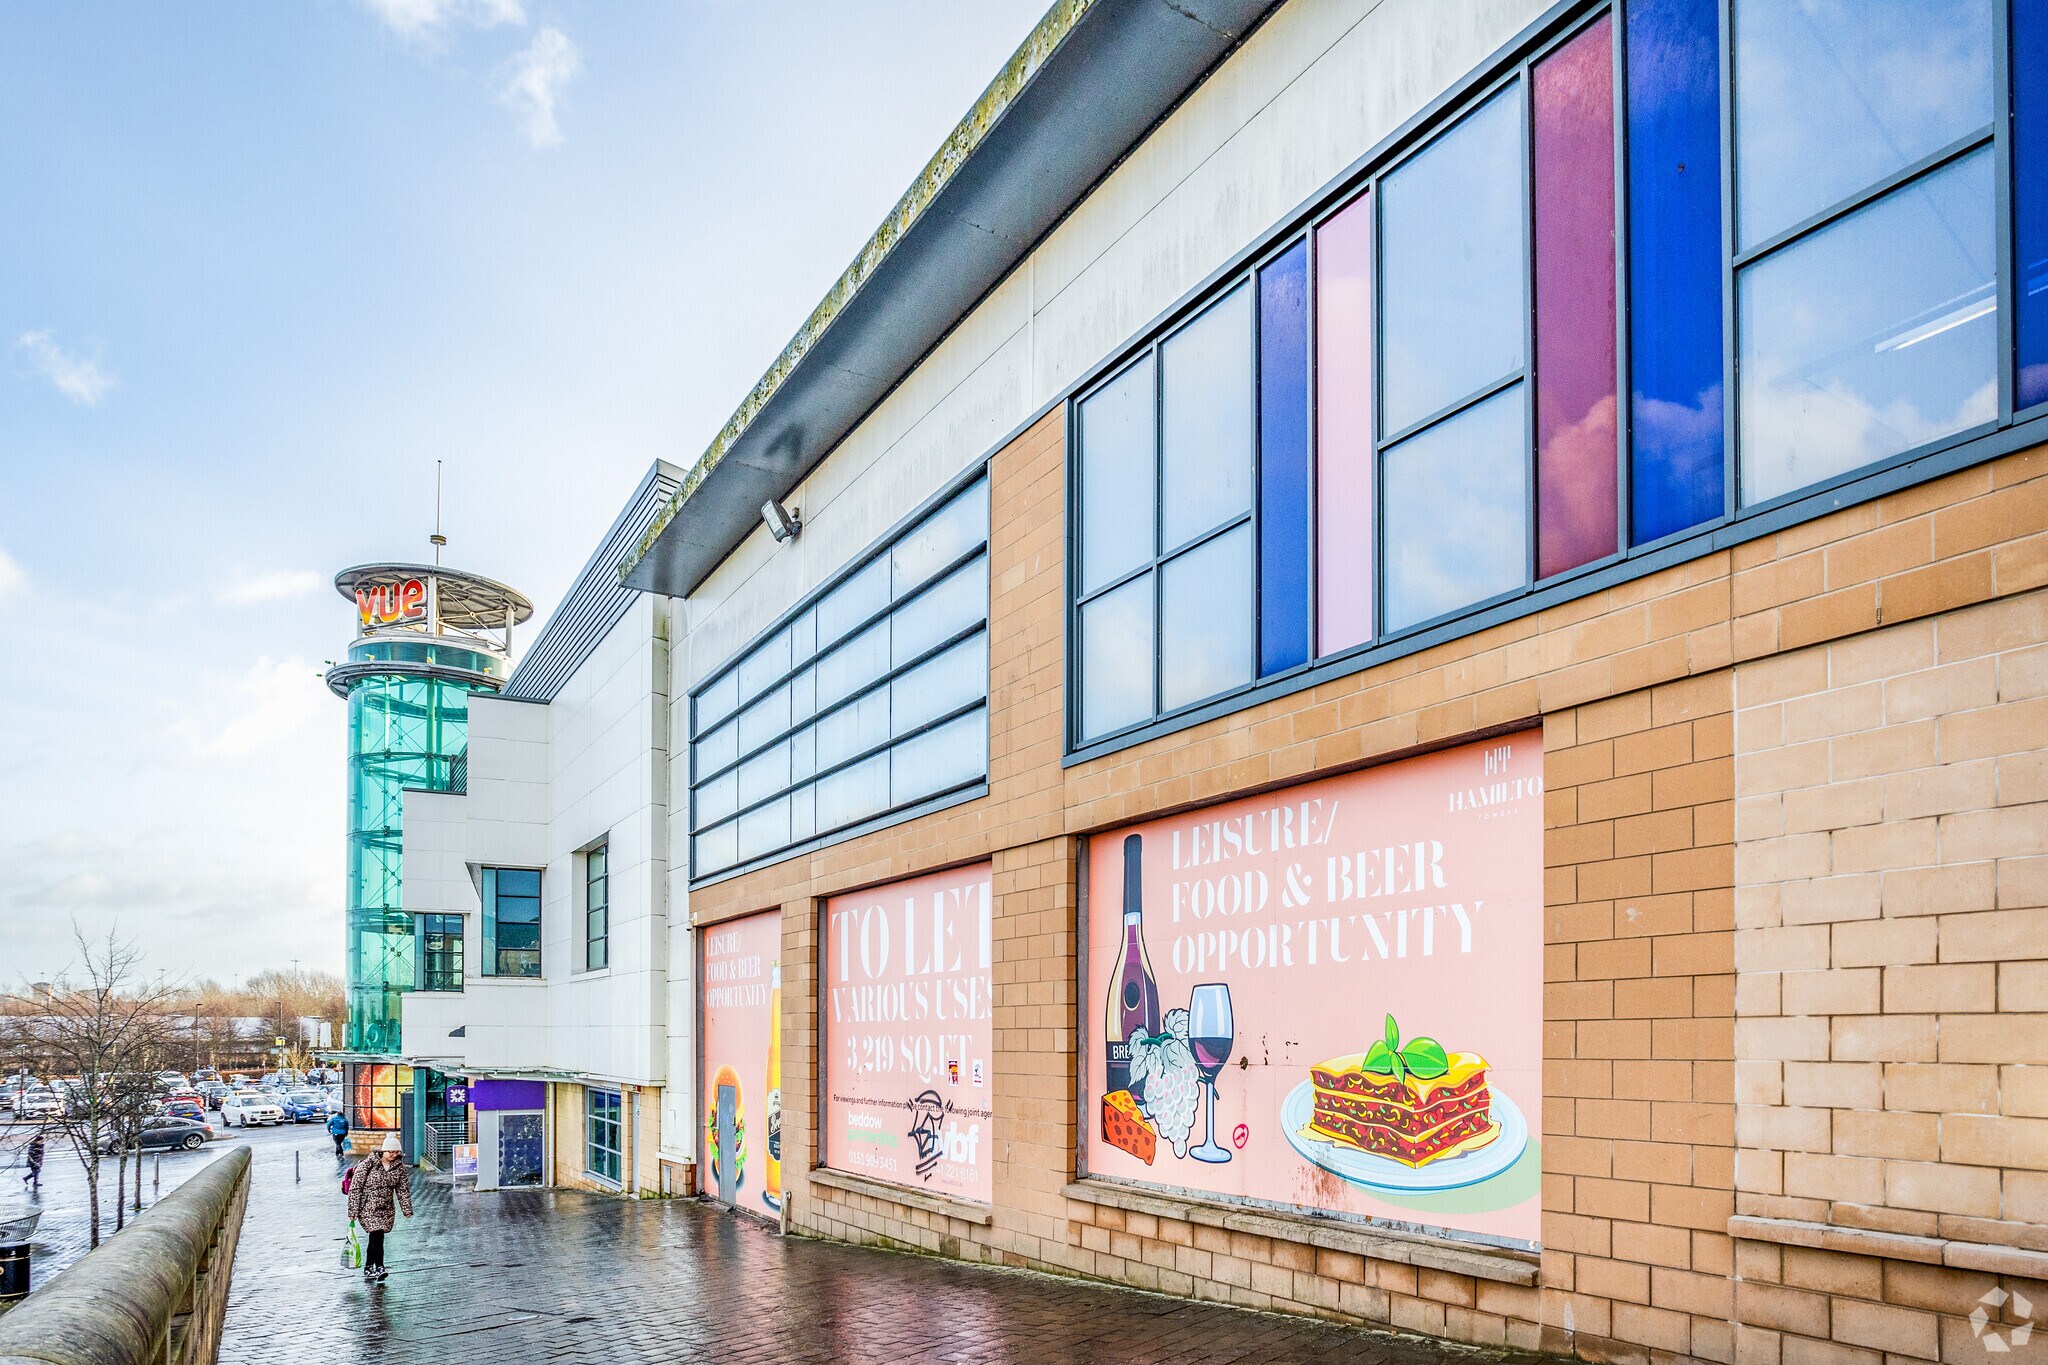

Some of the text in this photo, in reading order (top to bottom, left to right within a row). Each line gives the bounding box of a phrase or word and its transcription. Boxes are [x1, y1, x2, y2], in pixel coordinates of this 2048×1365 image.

[1478, 808, 1518, 820] TOWERS
[1172, 798, 1339, 870] LEISURE/
[1172, 840, 1449, 923] FOOD & BEER
[831, 881, 990, 981] TO LET
[1172, 900, 1486, 974] OPPORTUNITY
[706, 955, 761, 983] FOOD & BEER
[706, 983, 768, 1008] OPPORTUNITY
[832, 982, 929, 1023] VARIOUS
[847, 1035, 894, 1075] 3,219
[840, 1095, 855, 1105] viewings
[863, 1097, 877, 1106] further
[878, 1099, 902, 1108] information
[903, 1101, 917, 1111] plse
[918, 1104, 935, 1112] contact
[945, 1106, 967, 1117] foowing
[967, 1107, 980, 1117] joint
[848, 1110, 882, 1129] beddow
[848, 1129, 898, 1151] partnership
[848, 1151, 897, 1172] 0151 909 3451
[930, 1162, 944, 1176] 141
[945, 1164, 958, 1179] 221
[960, 1167, 978, 1183] 6161
